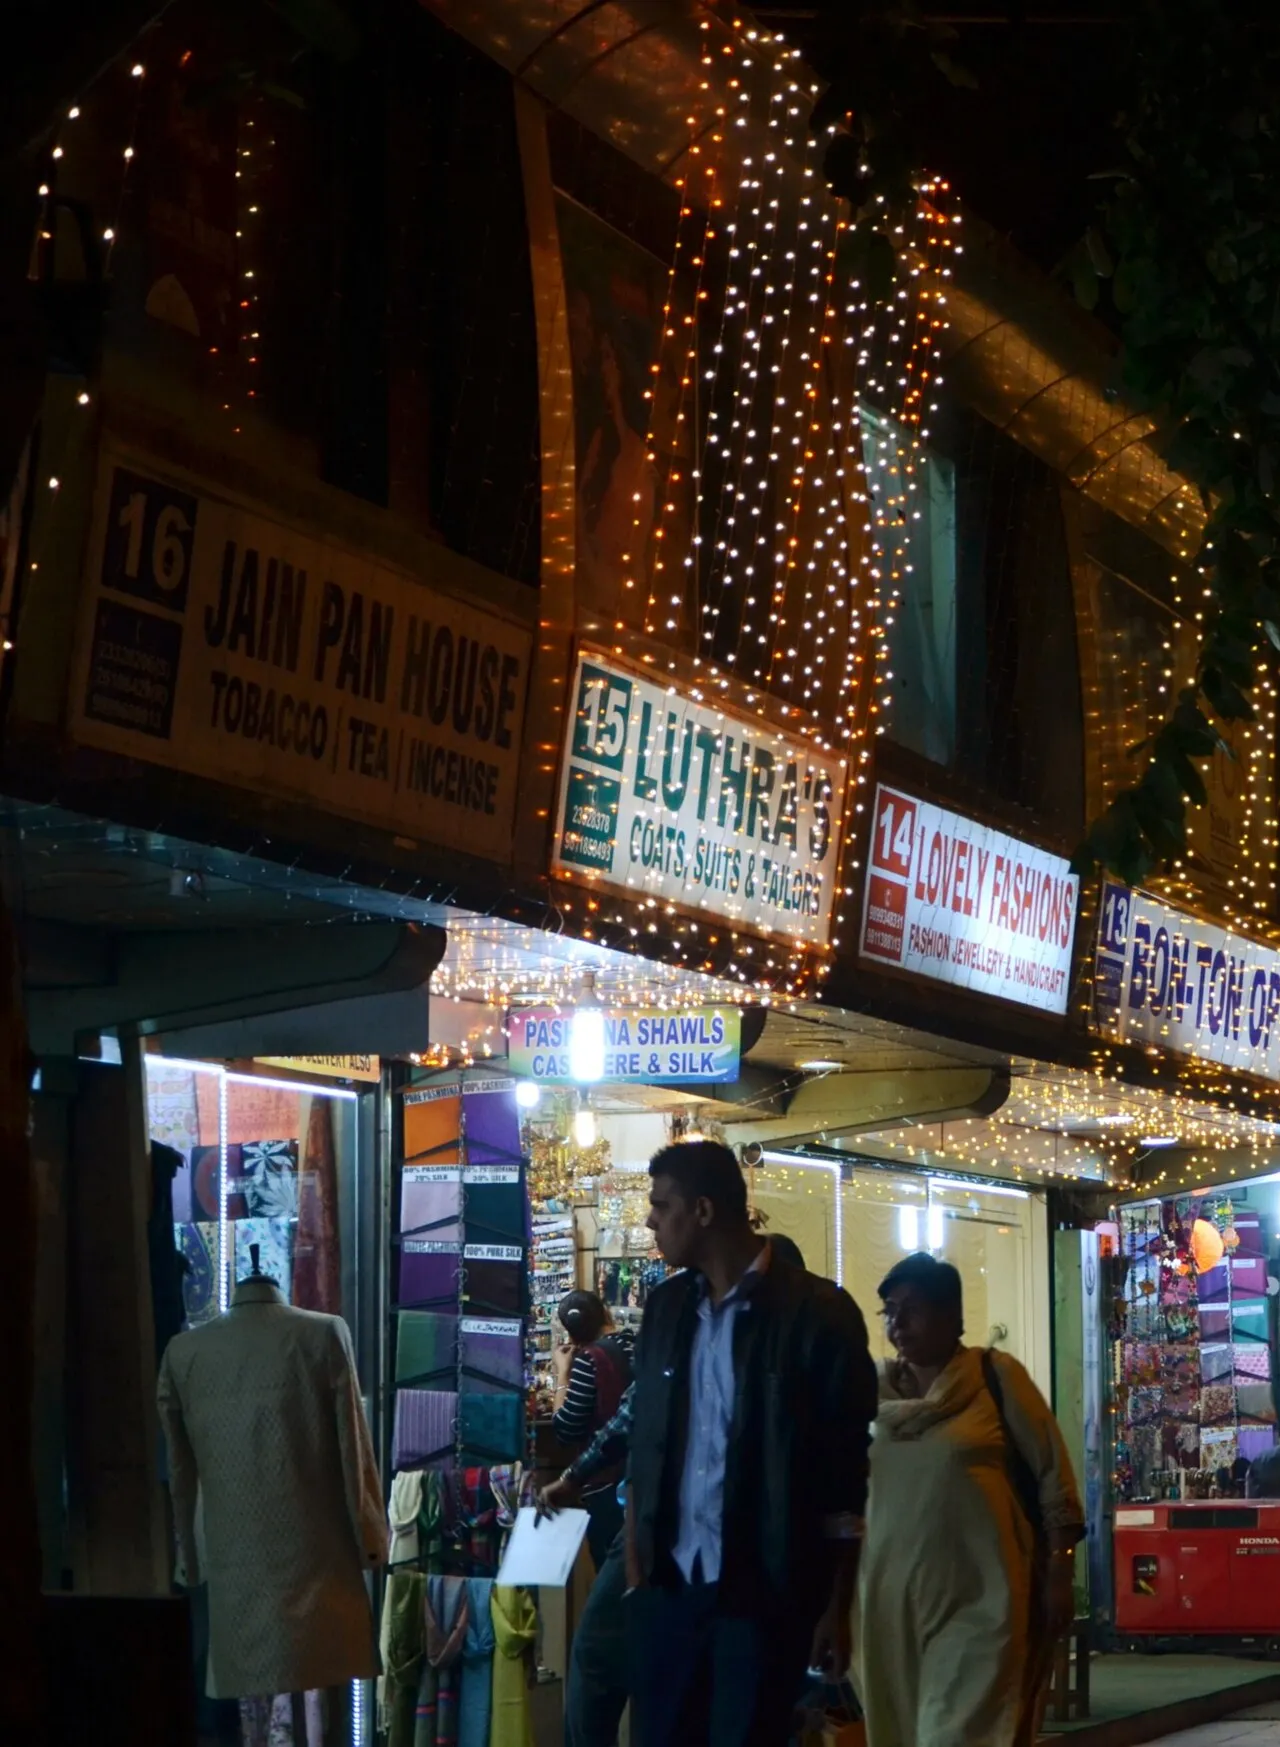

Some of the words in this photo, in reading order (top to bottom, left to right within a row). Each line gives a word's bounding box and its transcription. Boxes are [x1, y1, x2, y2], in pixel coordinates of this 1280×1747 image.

[119, 492, 193, 592] 16
[204, 539, 307, 674] JAIN
[316, 582, 395, 705] PAN
[400, 614, 519, 750] HOUSE
[210, 671, 328, 761] TOBACCO
[348, 717, 390, 782] TEA
[406, 737, 499, 816] INCENSE
[583, 680, 627, 757] 15
[633, 700, 833, 861] LUTHRA'S
[880, 802, 913, 867] 14
[693, 837, 742, 894] SUITS
[744, 856, 756, 899] &
[761, 858, 822, 916] TAILORS
[915, 826, 989, 919] LOVELY
[990, 855, 1073, 949] FASHIONS
[1106, 893, 1128, 946] 13
[909, 924, 951, 961] FASHION
[952, 939, 1005, 979] JEWELLERY
[1013, 958, 1066, 995] HANDICRAFT
[1129, 921, 1245, 1041] BON-TON
[533, 1053, 641, 1077] CASERE
[648, 1052, 661, 1074] &
[668, 1051, 714, 1074] SILK
[637, 1016, 724, 1045] SHAWLS
[486, 1247, 504, 1257] PURE
[506, 1247, 521, 1258] SILK
[1239, 1537, 1280, 1545] HONDA
